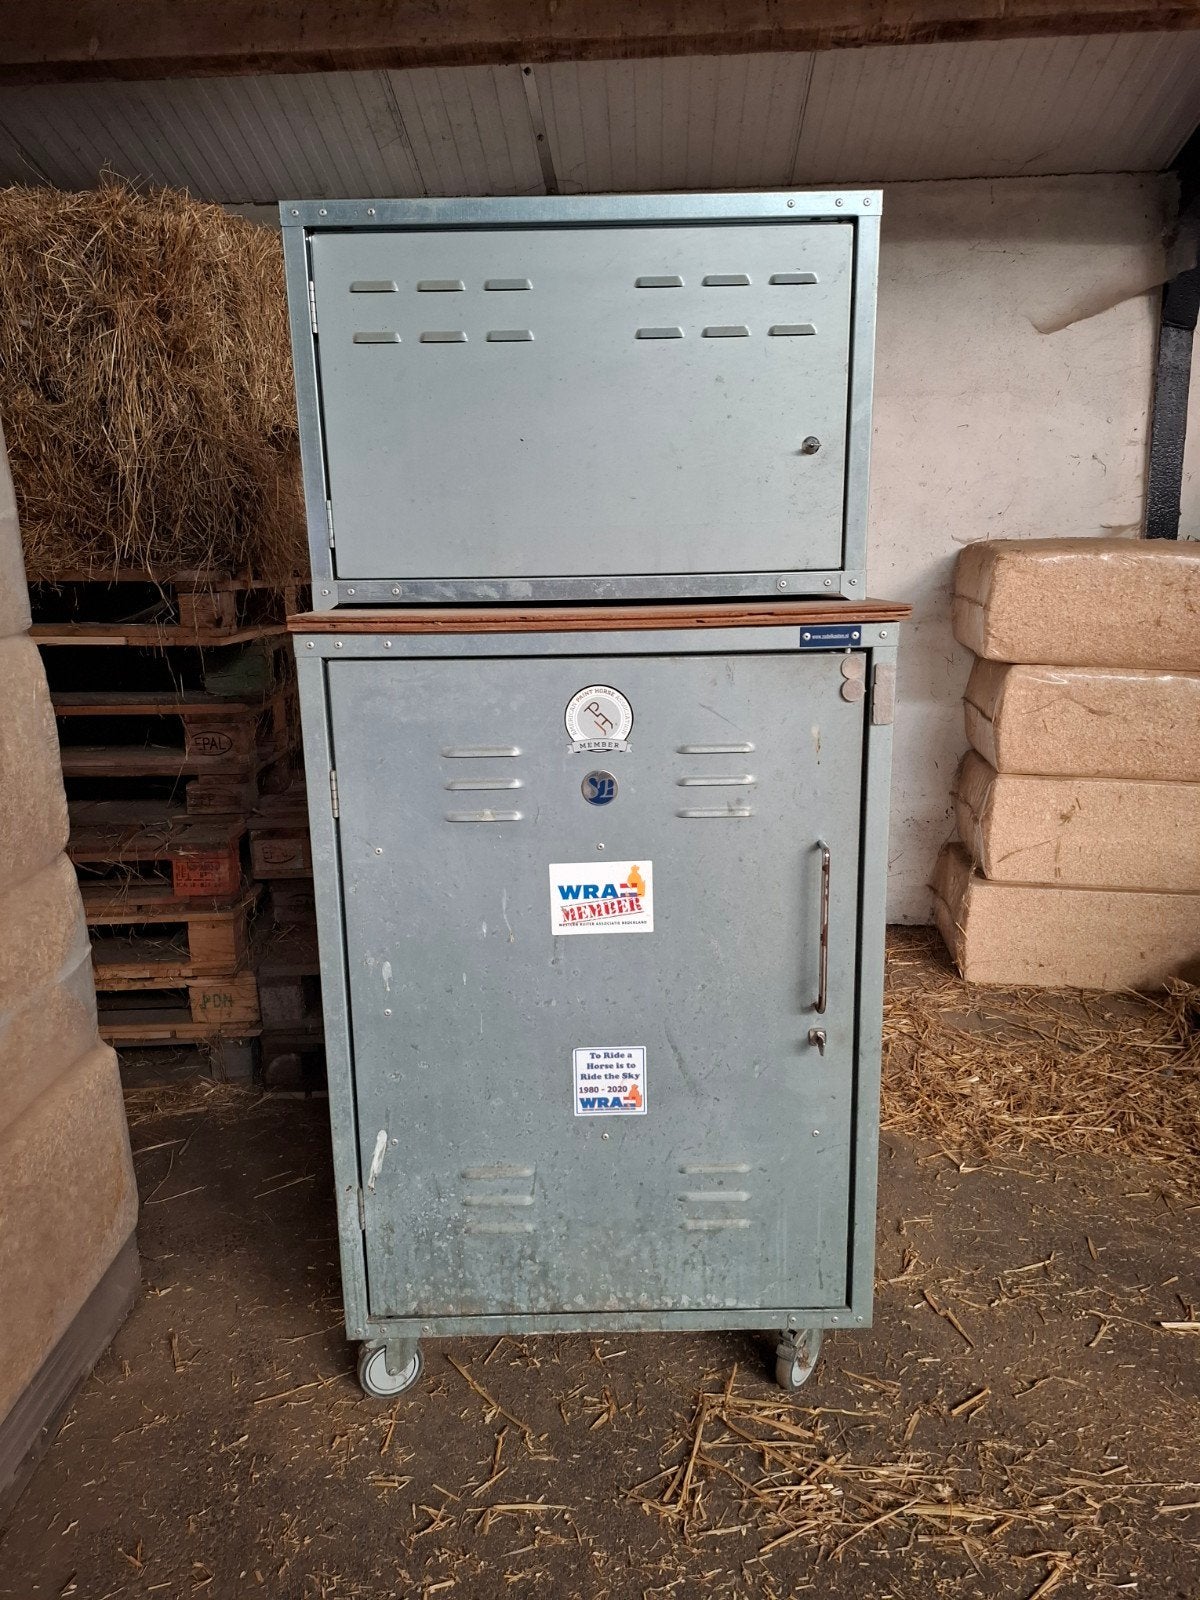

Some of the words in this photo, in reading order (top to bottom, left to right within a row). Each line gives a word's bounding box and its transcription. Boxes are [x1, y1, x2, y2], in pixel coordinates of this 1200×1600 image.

[576, 689, 593, 702] PAINT
[594, 688, 615, 697] HORSE
[194, 737, 226, 750] EPAL
[580, 741, 619, 749] MEMBER
[557, 884, 620, 900] WRA
[561, 897, 642, 922] MEMBER
[621, 1072, 640, 1080] Sky
[579, 1097, 623, 1108] WRA
